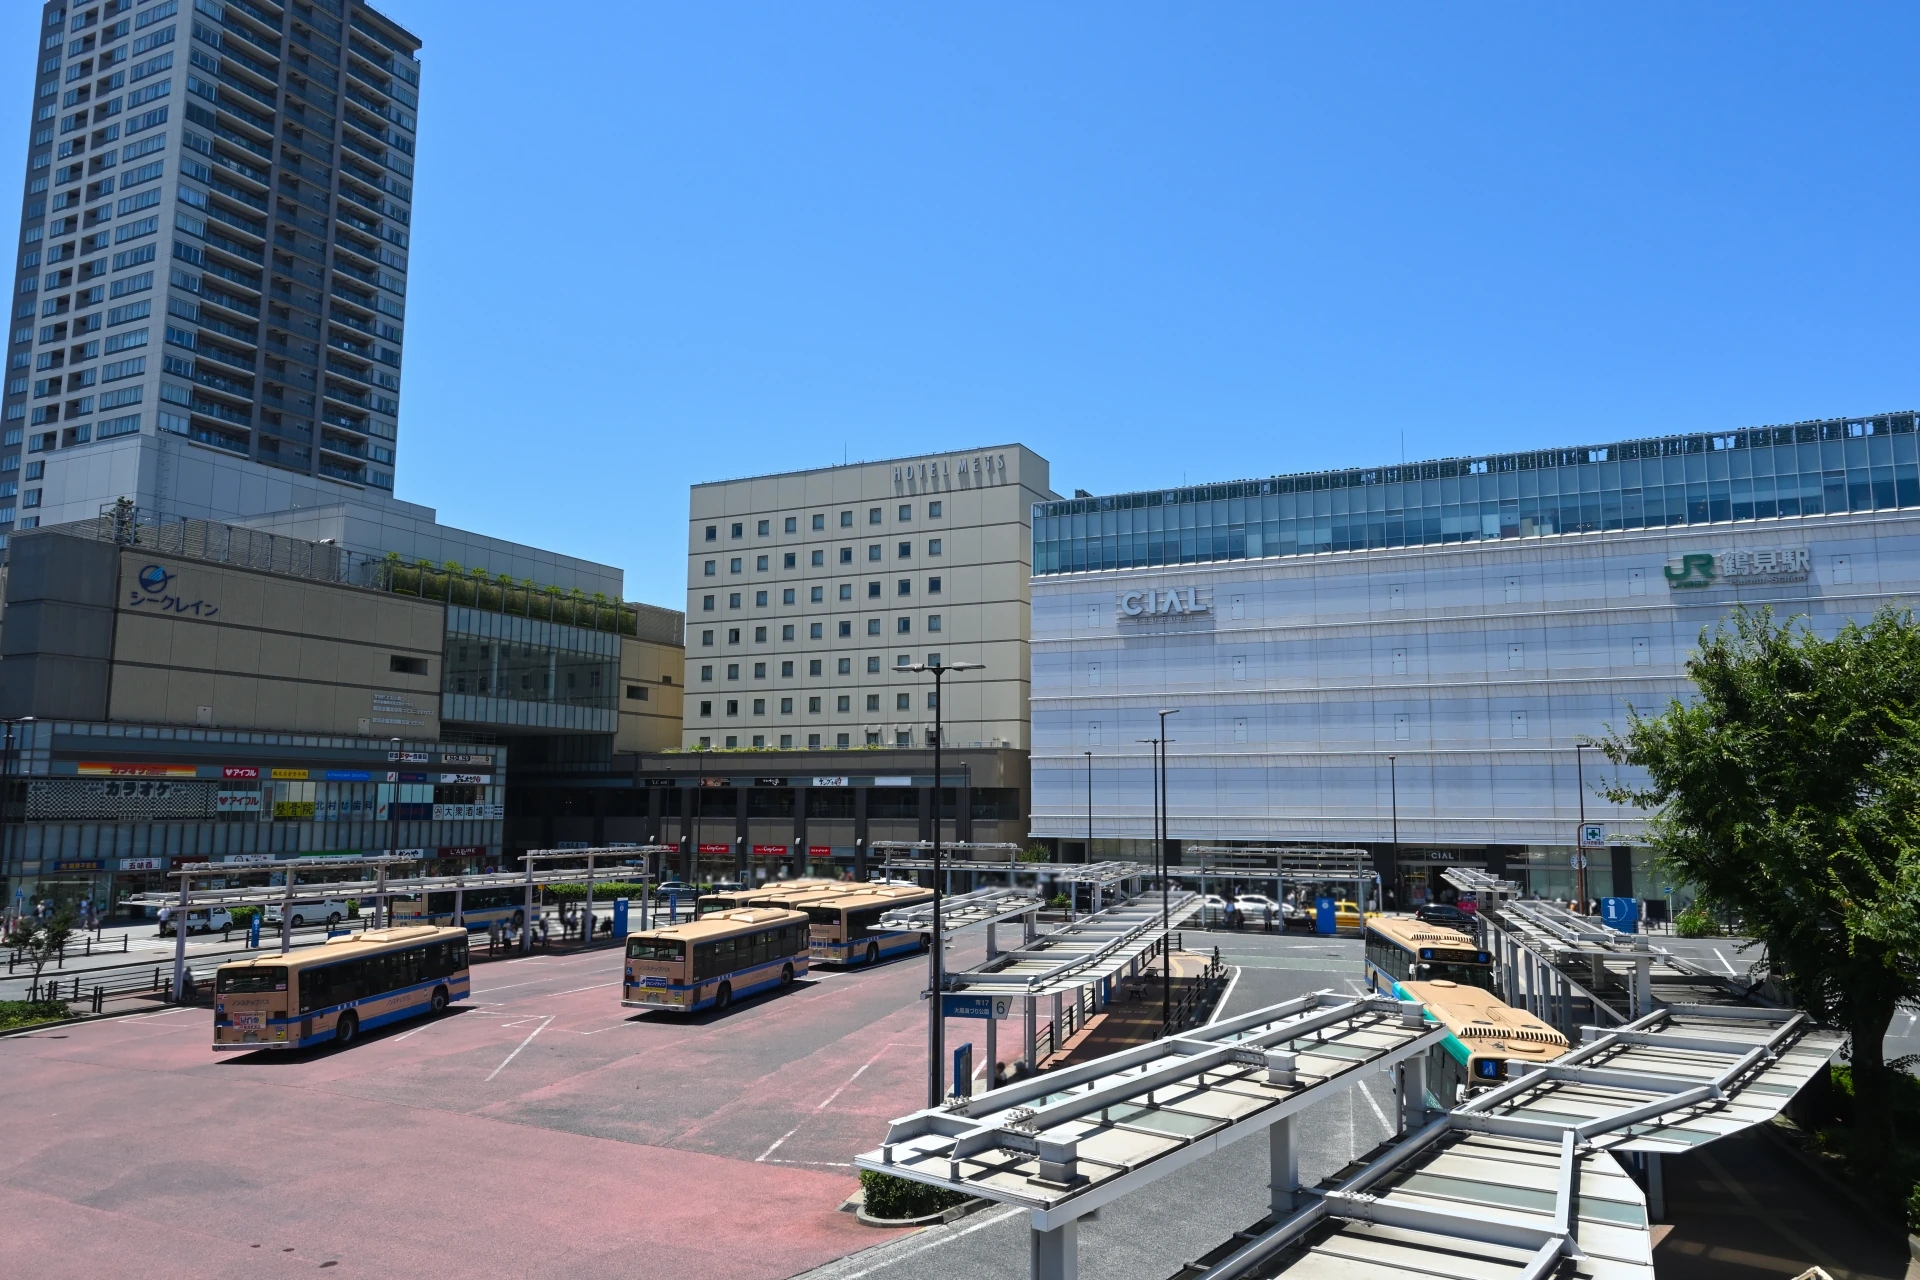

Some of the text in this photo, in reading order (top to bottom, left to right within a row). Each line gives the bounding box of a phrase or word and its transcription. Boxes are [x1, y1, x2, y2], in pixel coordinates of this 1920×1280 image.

[893, 453, 1005, 483] HOTEL METS
[1664, 552, 1717, 580] JR
[1722, 547, 1811, 577] 鶴見駅
[130, 591, 219, 617] シークレイン
[1121, 586, 1208, 617] CIAL
[1135, 616, 1194, 625] TSURUMI
[105, 782, 170, 798] カラオケ
[229, 796, 260, 806] アイフル
[276, 802, 314, 816] 整骨院
[445, 806, 484, 817] 大衆酒場
[1431, 852, 1455, 860] CIAL
[996, 1001, 1005, 1015] 6
